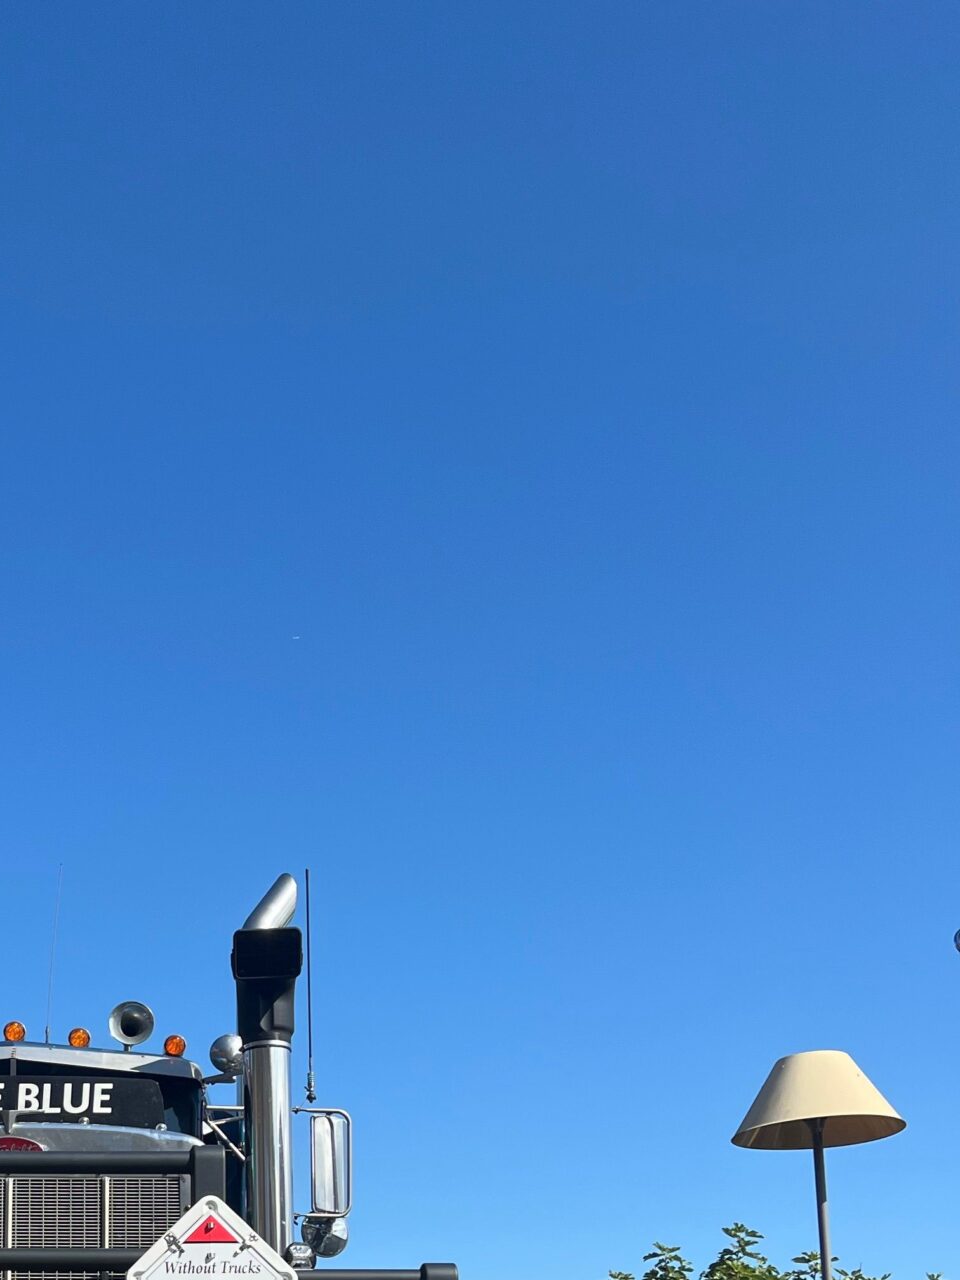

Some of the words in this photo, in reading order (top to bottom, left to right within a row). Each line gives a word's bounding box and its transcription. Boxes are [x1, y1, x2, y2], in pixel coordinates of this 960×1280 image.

[17, 1082, 114, 1114] BLUE
[164, 1260, 216, 1274] Without
[220, 1260, 261, 1274] Trucks
